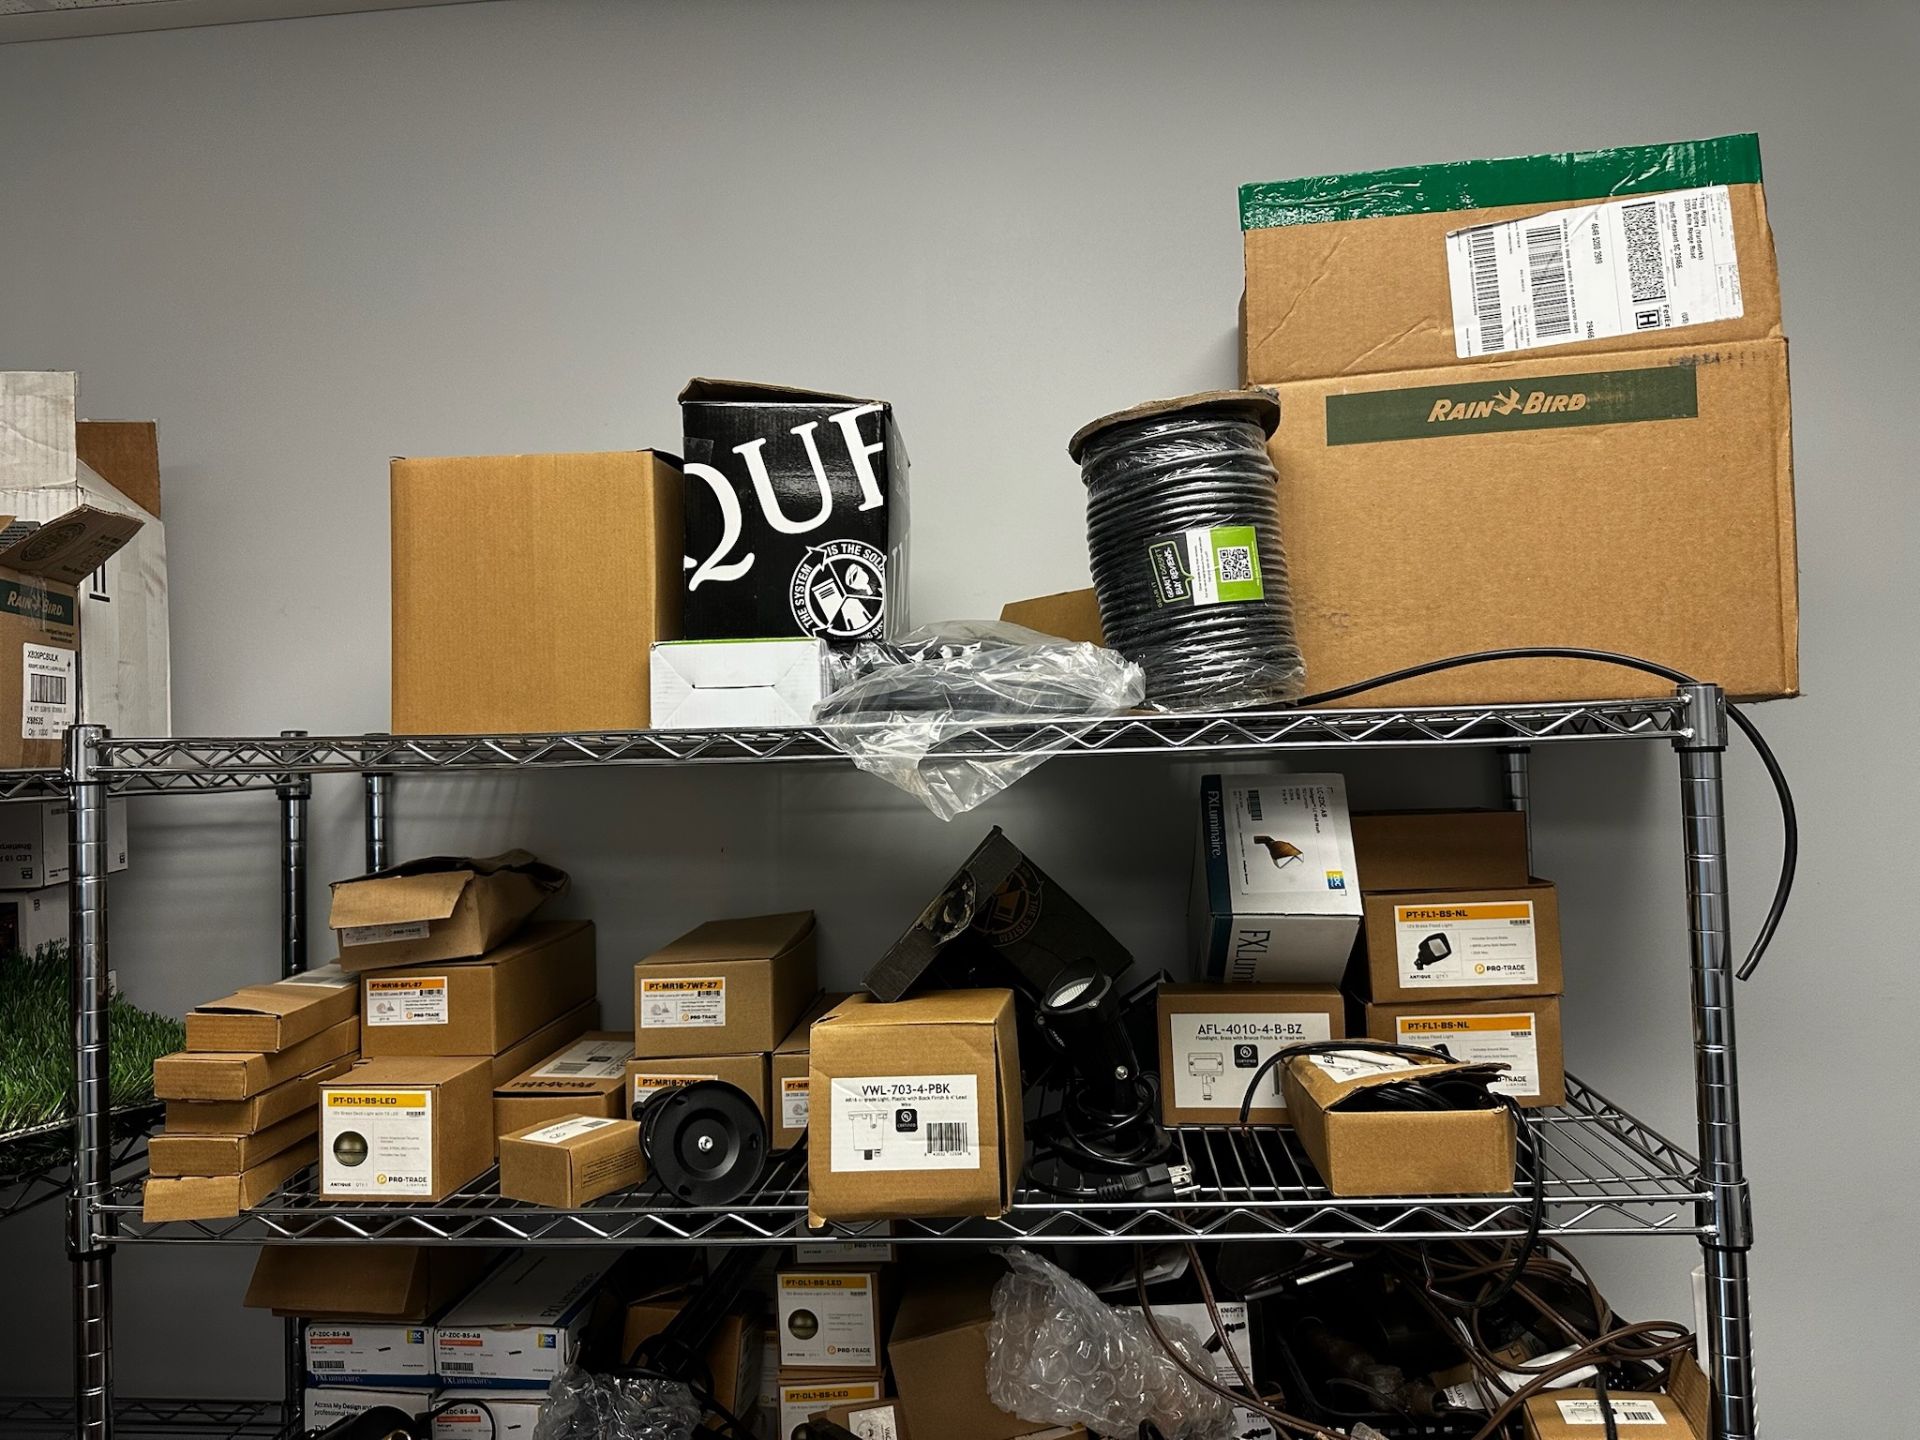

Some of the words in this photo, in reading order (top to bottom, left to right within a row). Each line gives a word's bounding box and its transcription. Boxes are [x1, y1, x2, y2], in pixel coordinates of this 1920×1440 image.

[1662, 304, 1672, 327] FedEx
[827, 545, 839, 557] IS
[840, 543, 862, 557] THE
[794, 563, 813, 605] SYSTEM
[1173, 580, 1184, 596] BUY
[797, 605, 813, 628] THE
[1406, 910, 1468, 918] PT-FL1-BS-NL
[1198, 1024, 1303, 1034] AFL-4010-4-B-BZ
[1408, 1022, 1470, 1030] PT-FL1-BS-NL
[862, 1084, 951, 1095] VWL-703-4-PBK
